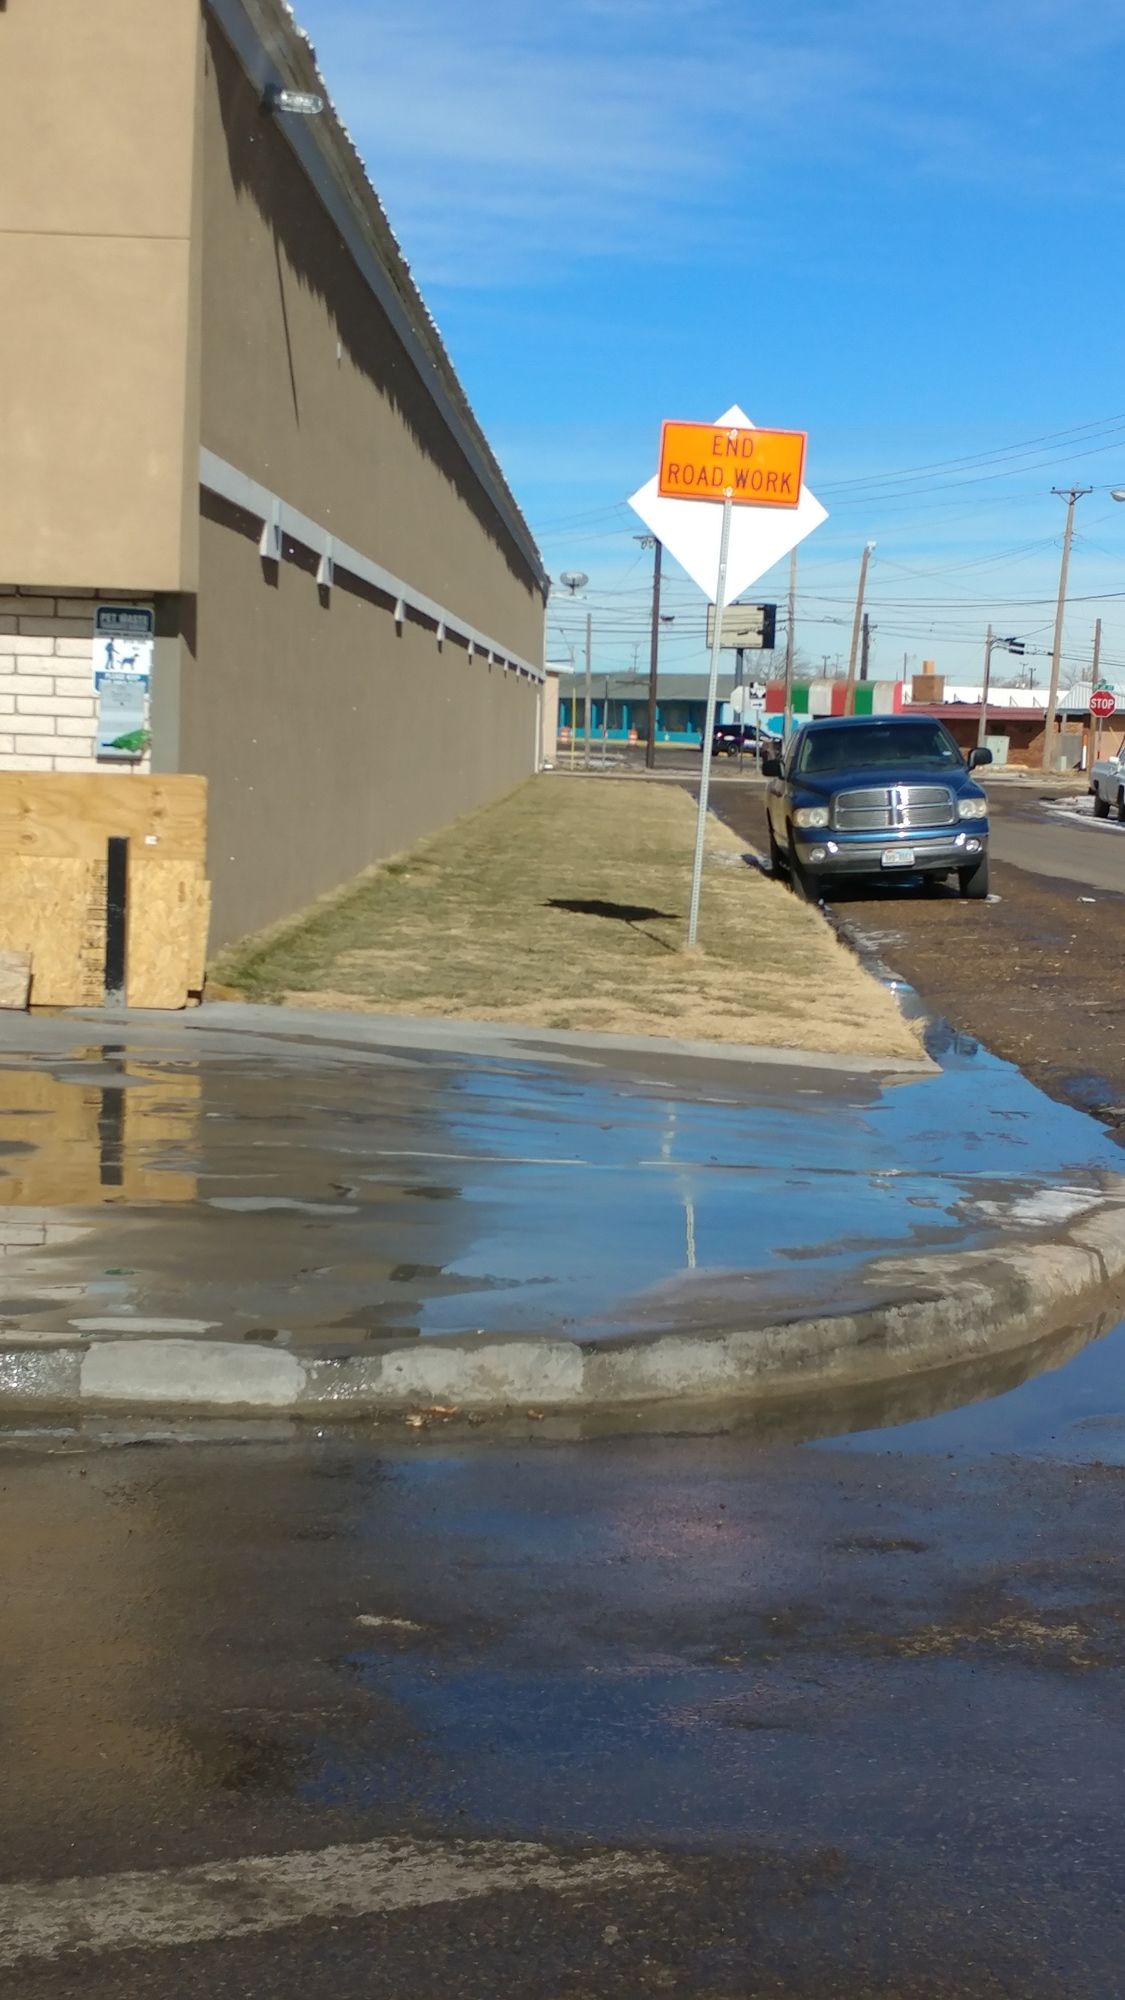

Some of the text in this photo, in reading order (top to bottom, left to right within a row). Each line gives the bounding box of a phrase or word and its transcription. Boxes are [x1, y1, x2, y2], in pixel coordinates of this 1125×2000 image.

[712, 435, 754, 458] END
[667, 463, 794, 495] ROAD WORK
[1090, 698, 1114, 710] STOP
